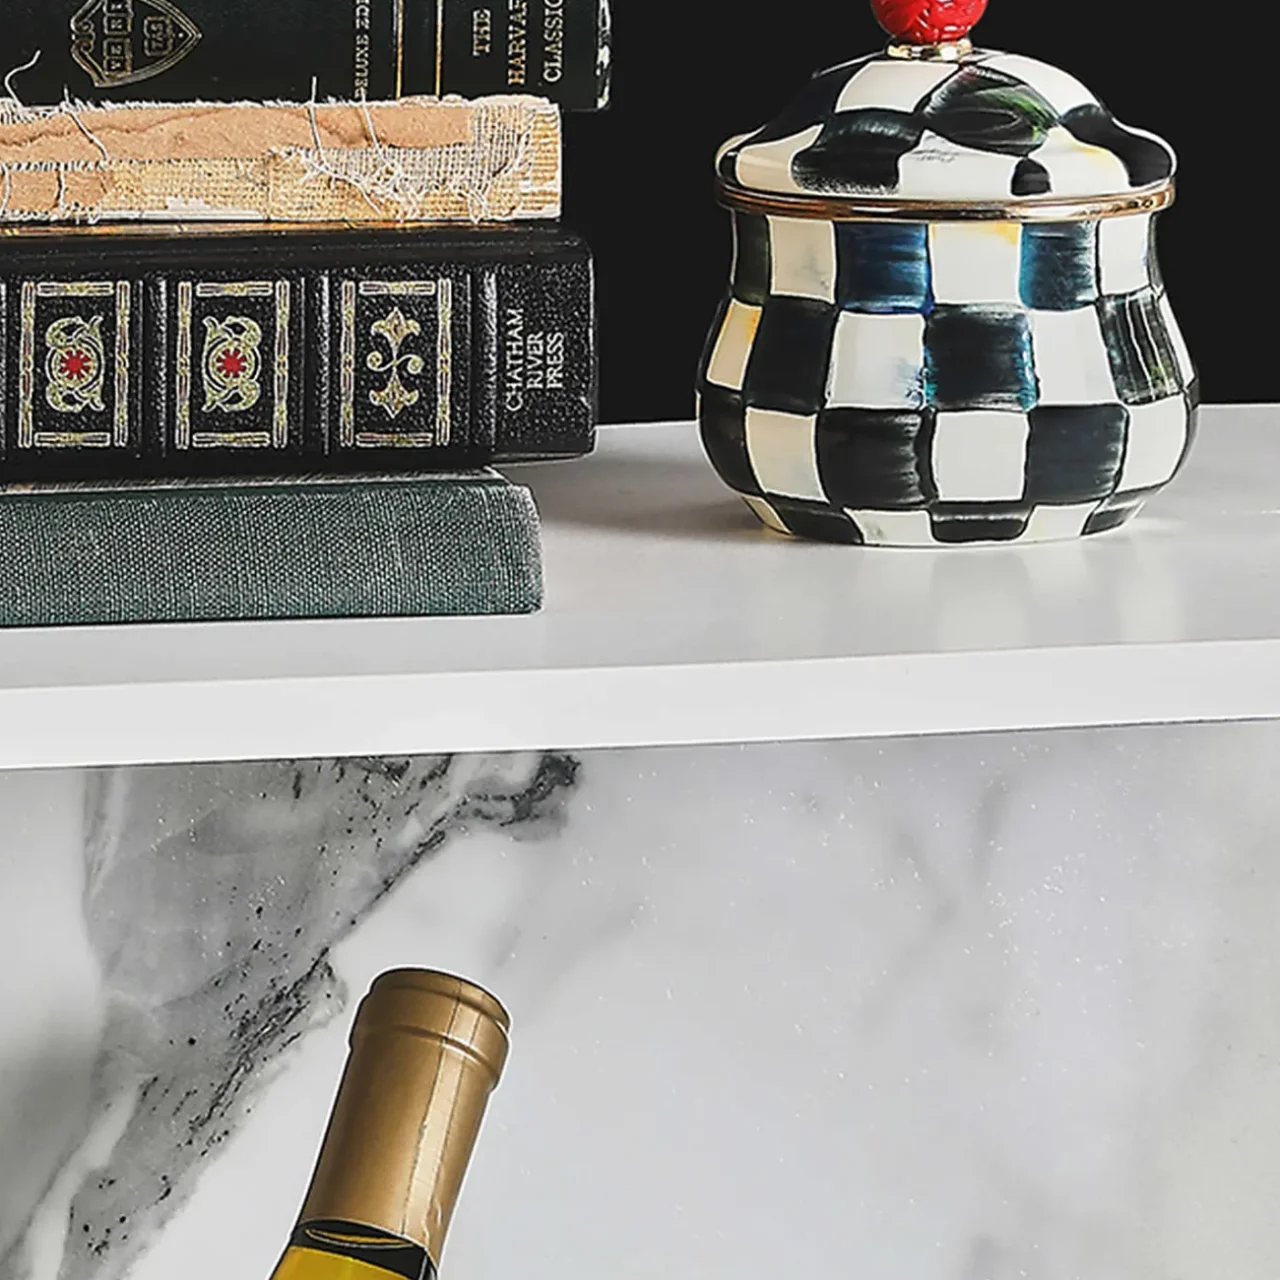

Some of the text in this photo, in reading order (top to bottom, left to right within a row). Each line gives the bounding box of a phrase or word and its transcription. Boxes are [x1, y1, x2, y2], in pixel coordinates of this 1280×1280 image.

[473, 9, 491, 57] THE
[506, 308, 524, 412] CHATHAM
[526, 331, 544, 389] RIVER
[546, 332, 564, 389] PRESS
